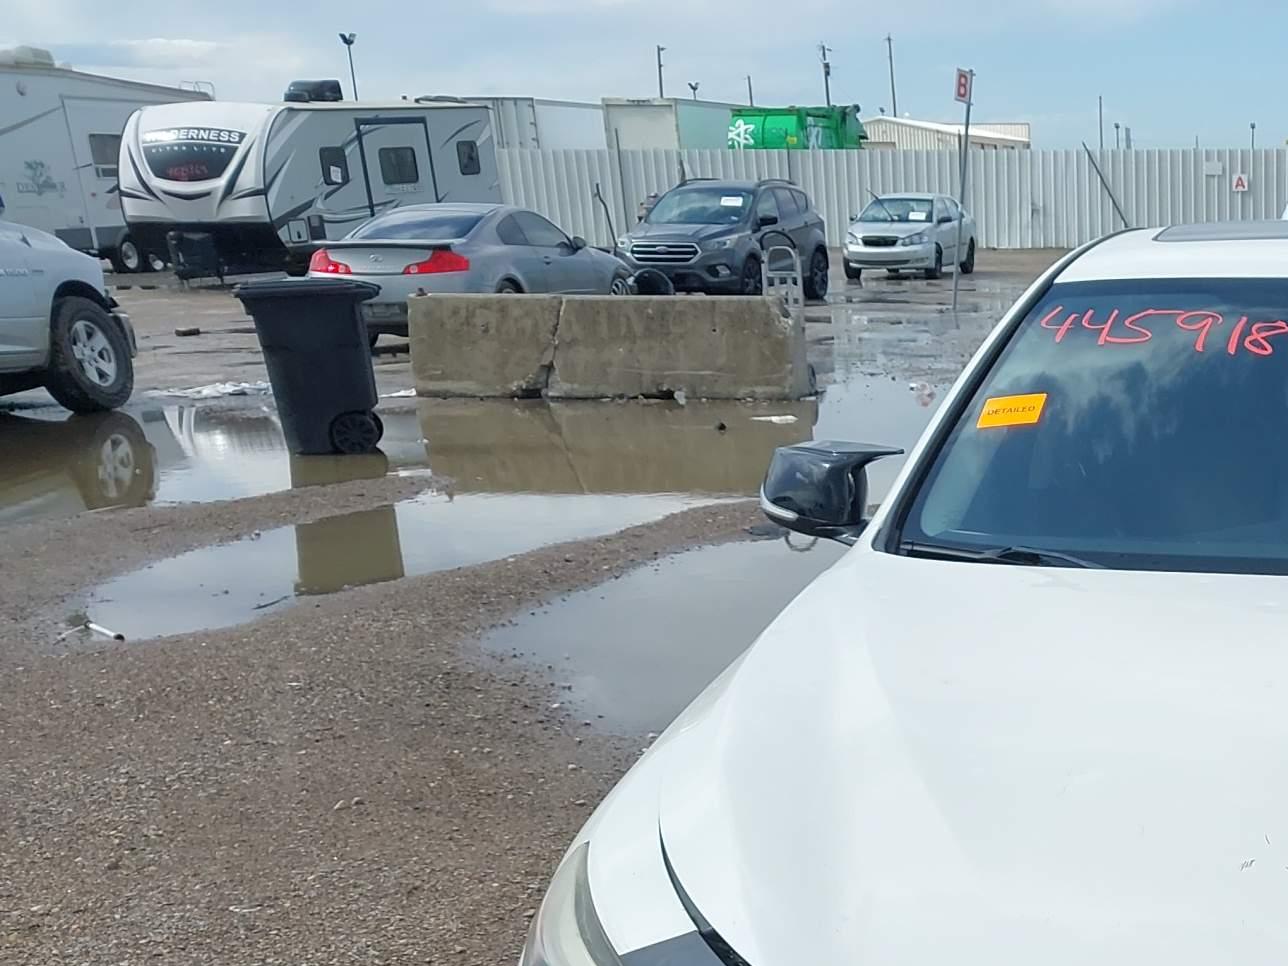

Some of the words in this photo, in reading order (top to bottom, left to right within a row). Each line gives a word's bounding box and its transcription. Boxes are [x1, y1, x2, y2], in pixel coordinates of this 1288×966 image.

[957, 73, 969, 98] B
[143, 128, 240, 142] WDERNESS
[1234, 175, 1246, 190] A
[986, 405, 1036, 415] DETAILED
